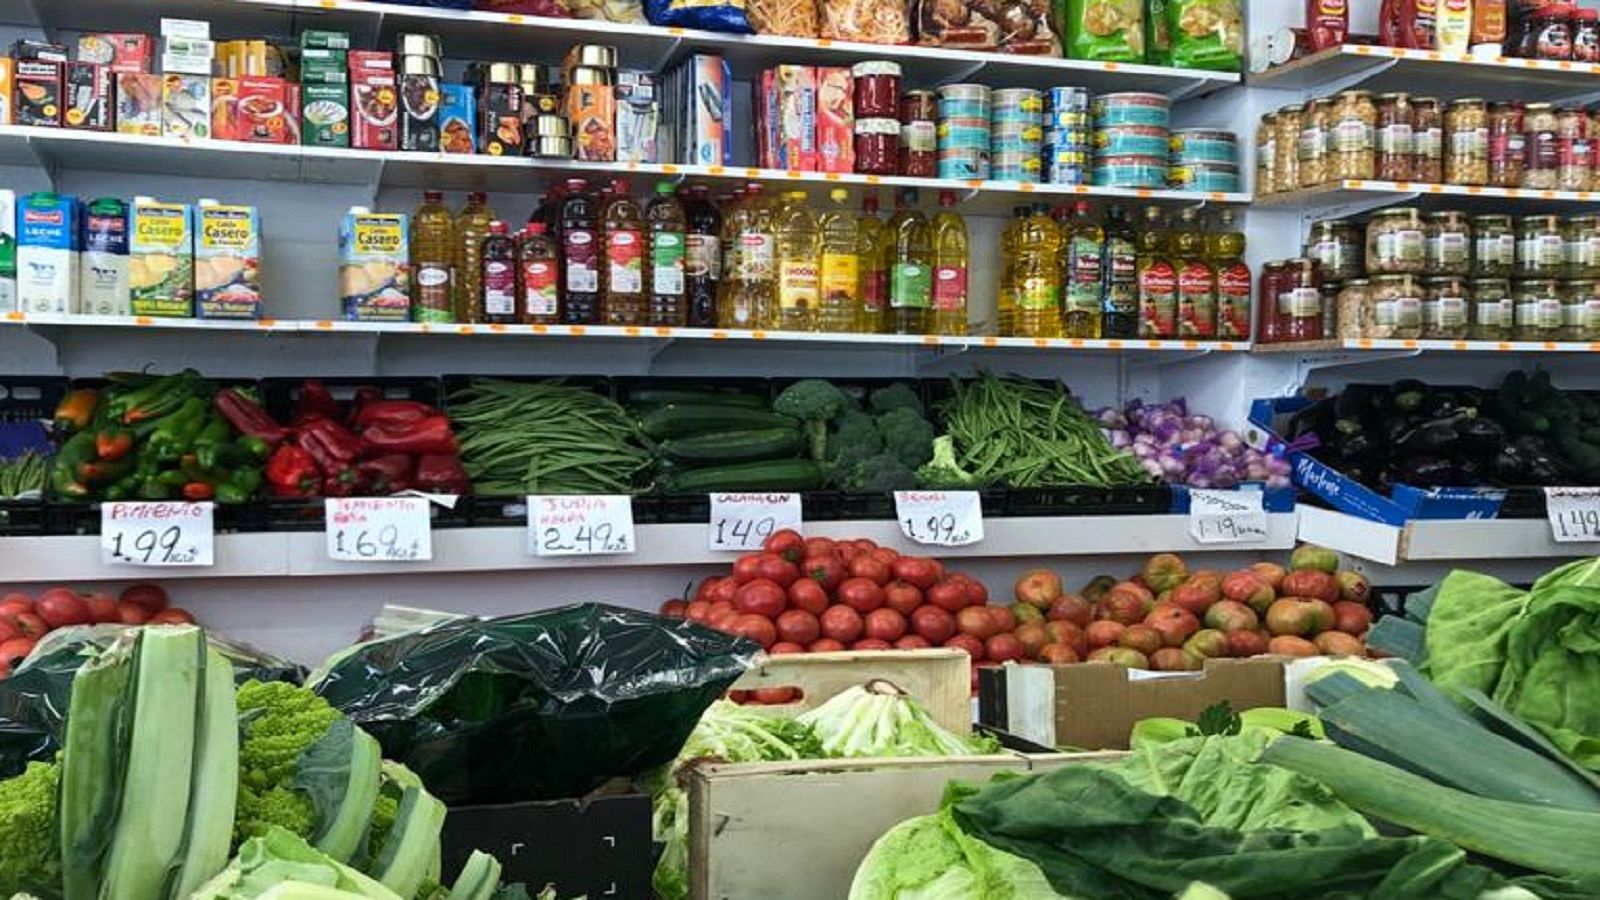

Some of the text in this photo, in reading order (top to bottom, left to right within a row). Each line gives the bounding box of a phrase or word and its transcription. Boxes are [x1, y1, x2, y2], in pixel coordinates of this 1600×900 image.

[25, 227, 63, 237] LECHE
[138, 222, 183, 237] Casero
[204, 225, 249, 239] Casero
[359, 231, 400, 245] Casero
[113, 525, 181, 563] 1.99
[336, 524, 398, 557] 1.69
[545, 522, 613, 552] 2.49
